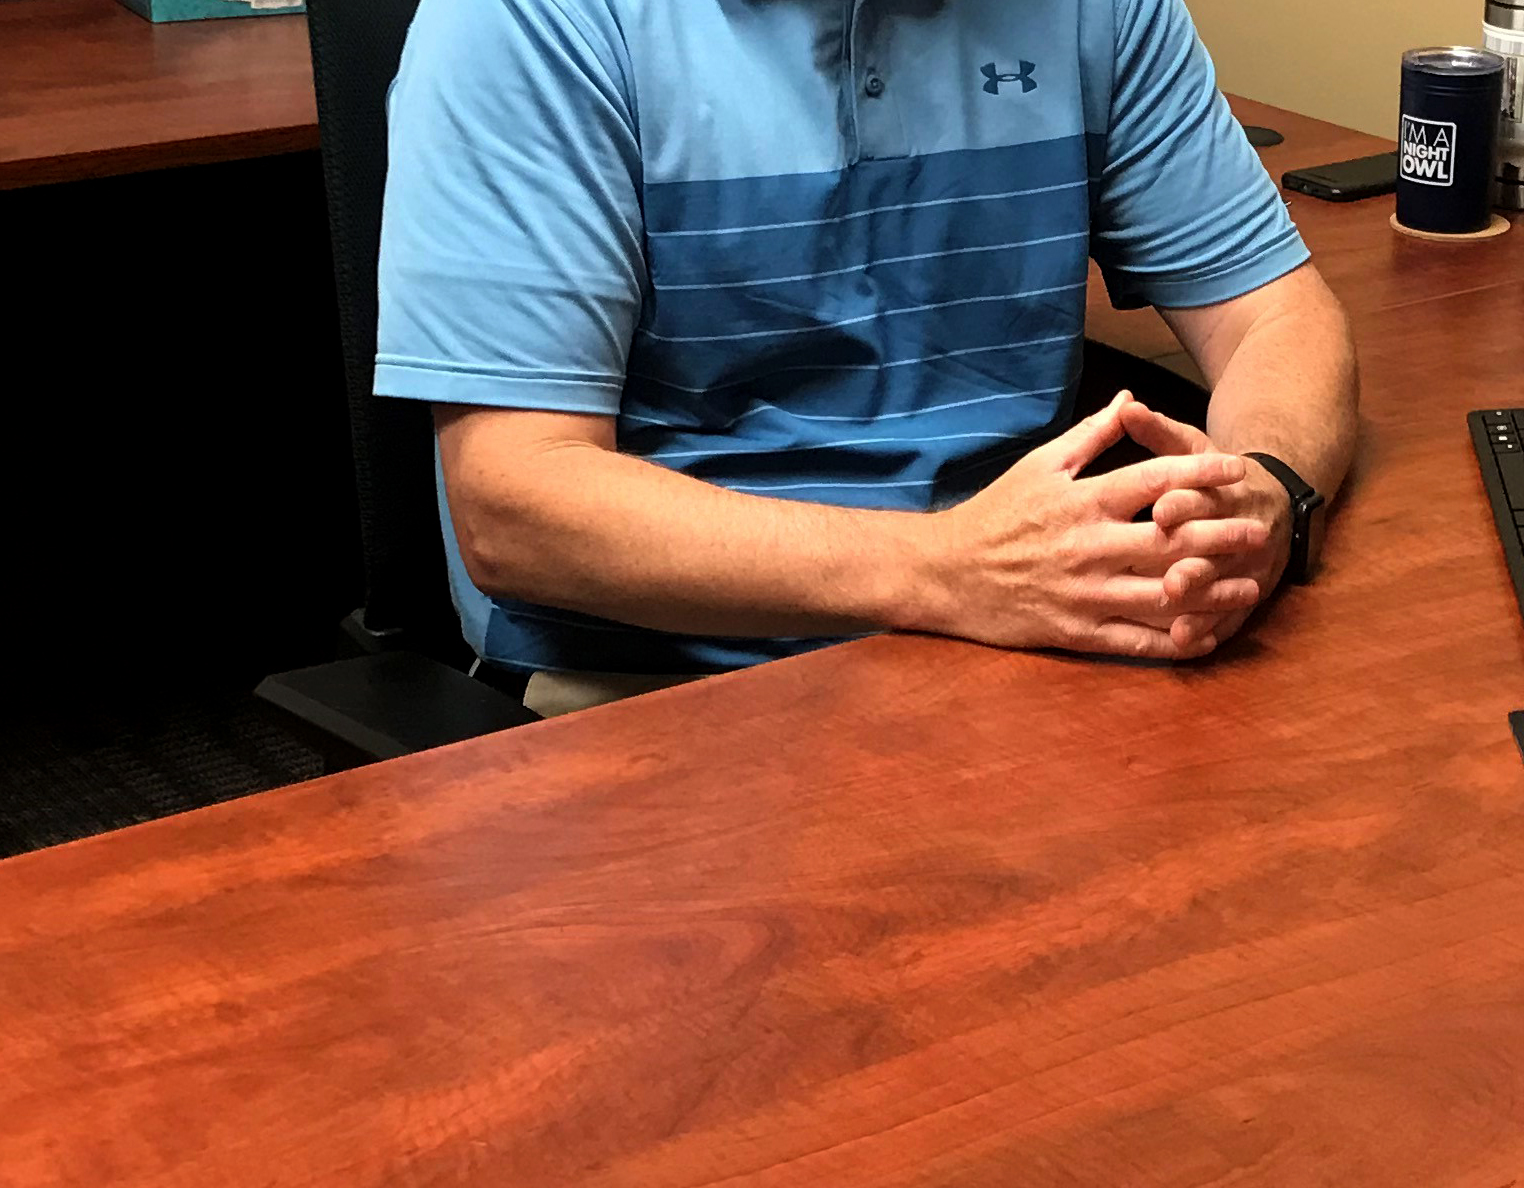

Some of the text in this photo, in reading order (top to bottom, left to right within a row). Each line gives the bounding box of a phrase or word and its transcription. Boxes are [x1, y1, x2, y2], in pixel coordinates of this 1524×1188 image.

[1404, 121, 1450, 147] I'M A
[1404, 140, 1450, 161] NIGHT
[1403, 154, 1449, 179] OWL
